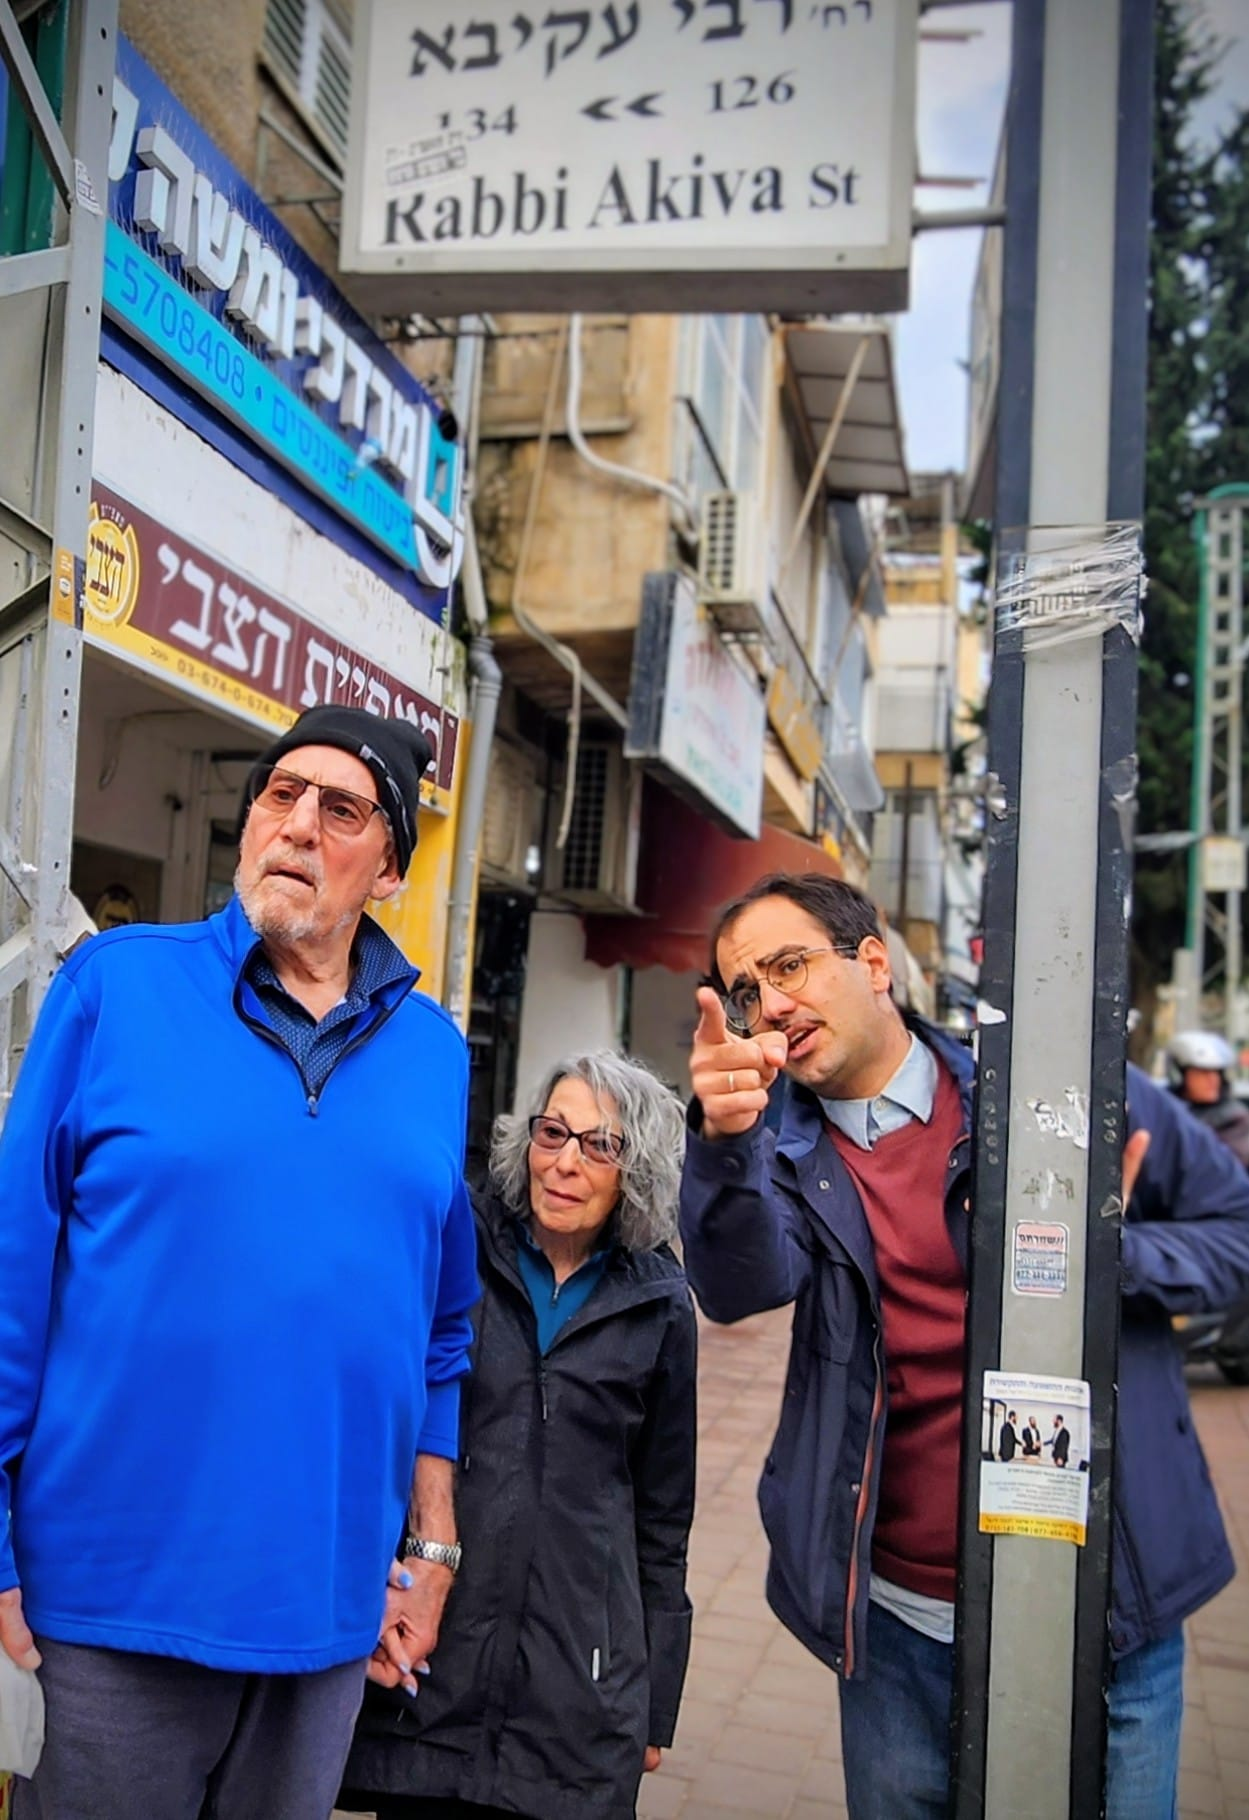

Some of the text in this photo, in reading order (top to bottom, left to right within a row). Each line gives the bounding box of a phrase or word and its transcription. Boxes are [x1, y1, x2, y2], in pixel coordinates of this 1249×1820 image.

[408, 1, 639, 79] עקיבא
[708, 70, 796, 114] 126
[380, 154, 861, 246] Rabbi Akiva St
[157, 543, 292, 690] הצבי
